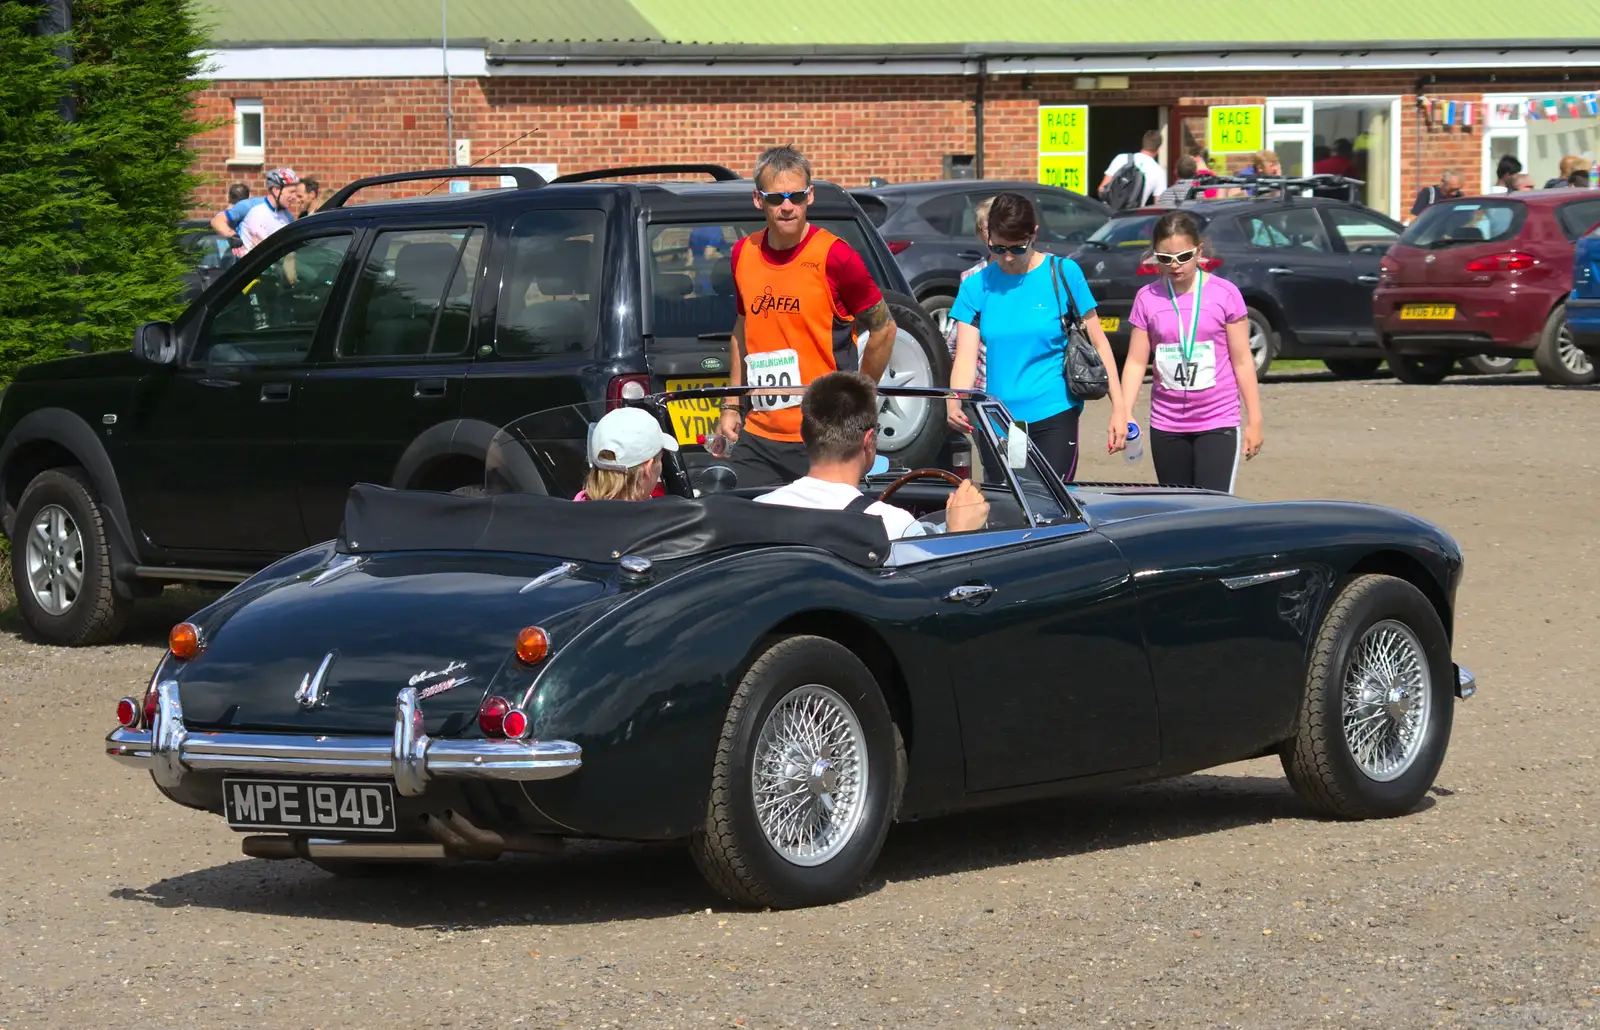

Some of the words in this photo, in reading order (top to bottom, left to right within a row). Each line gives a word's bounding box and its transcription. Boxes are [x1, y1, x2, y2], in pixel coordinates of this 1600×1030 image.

[1047, 112, 1077, 127] RACE
[1217, 111, 1251, 125] RACE
[1049, 131, 1075, 146] H.Q.
[1045, 167, 1080, 188] TOILETS
[1174, 362, 1198, 387] 47
[233, 784, 301, 823] MPE
[307, 786, 384, 826] 194D
